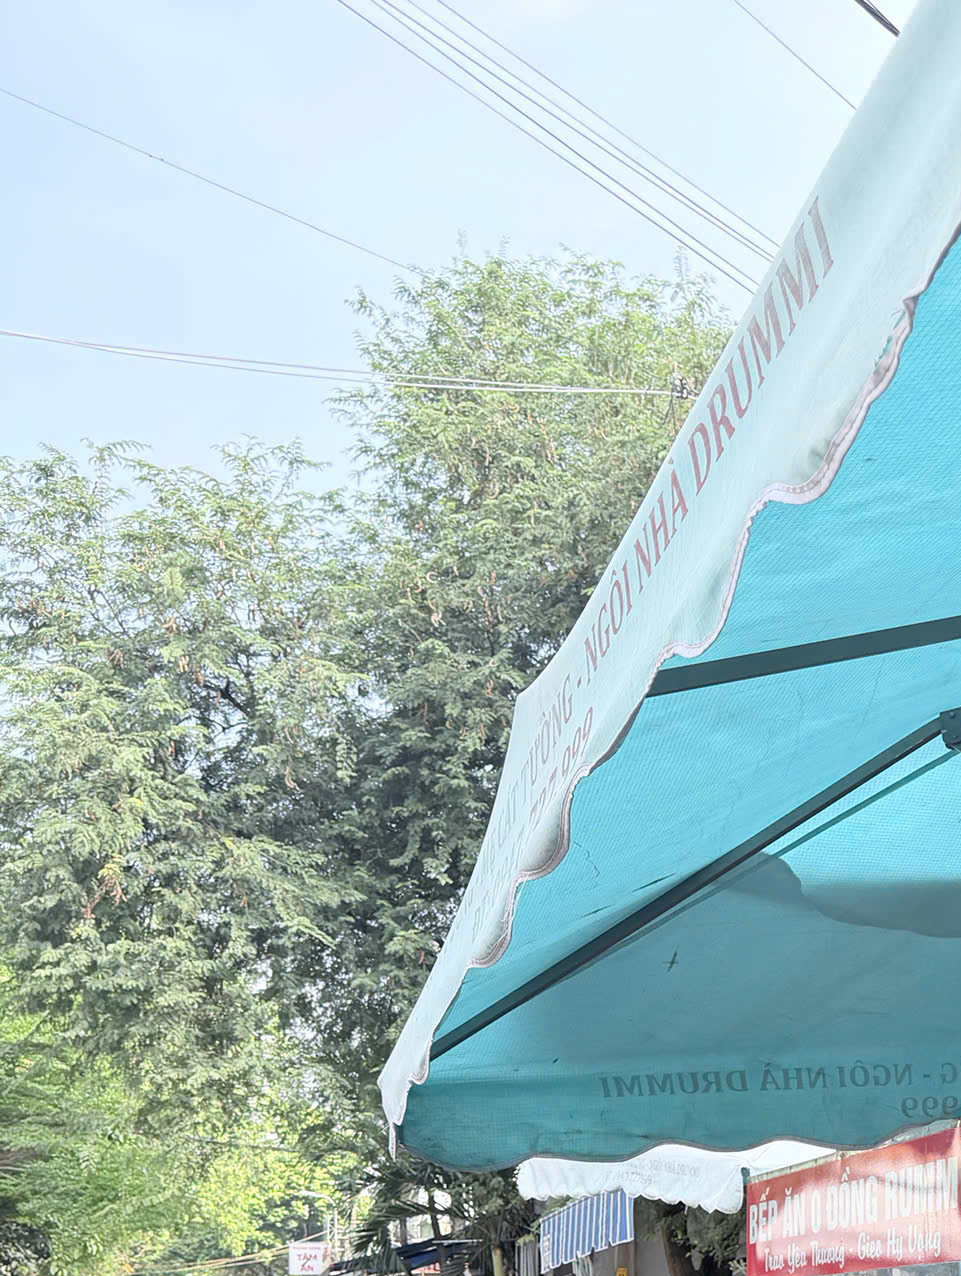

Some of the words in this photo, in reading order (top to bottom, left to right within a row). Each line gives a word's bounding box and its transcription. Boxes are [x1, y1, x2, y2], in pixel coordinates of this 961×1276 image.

[521, 673, 573, 803] TƯỜNG
[584, 559, 632, 685] NGÔI
[634, 456, 689, 594] NHÀ
[688, 194, 834, 497] DRUMMI
[750, 1186, 778, 1245] BẾP
[783, 1186, 807, 1239] ĂN
[827, 1166, 880, 1231] ĐỒNG
[764, 1247, 785, 1273] Trao
[787, 1246, 807, 1274] Yêu
[857, 1231, 882, 1261] Gieo
[886, 1227, 904, 1261] Hy
[907, 1223, 942, 1261] Vọng
